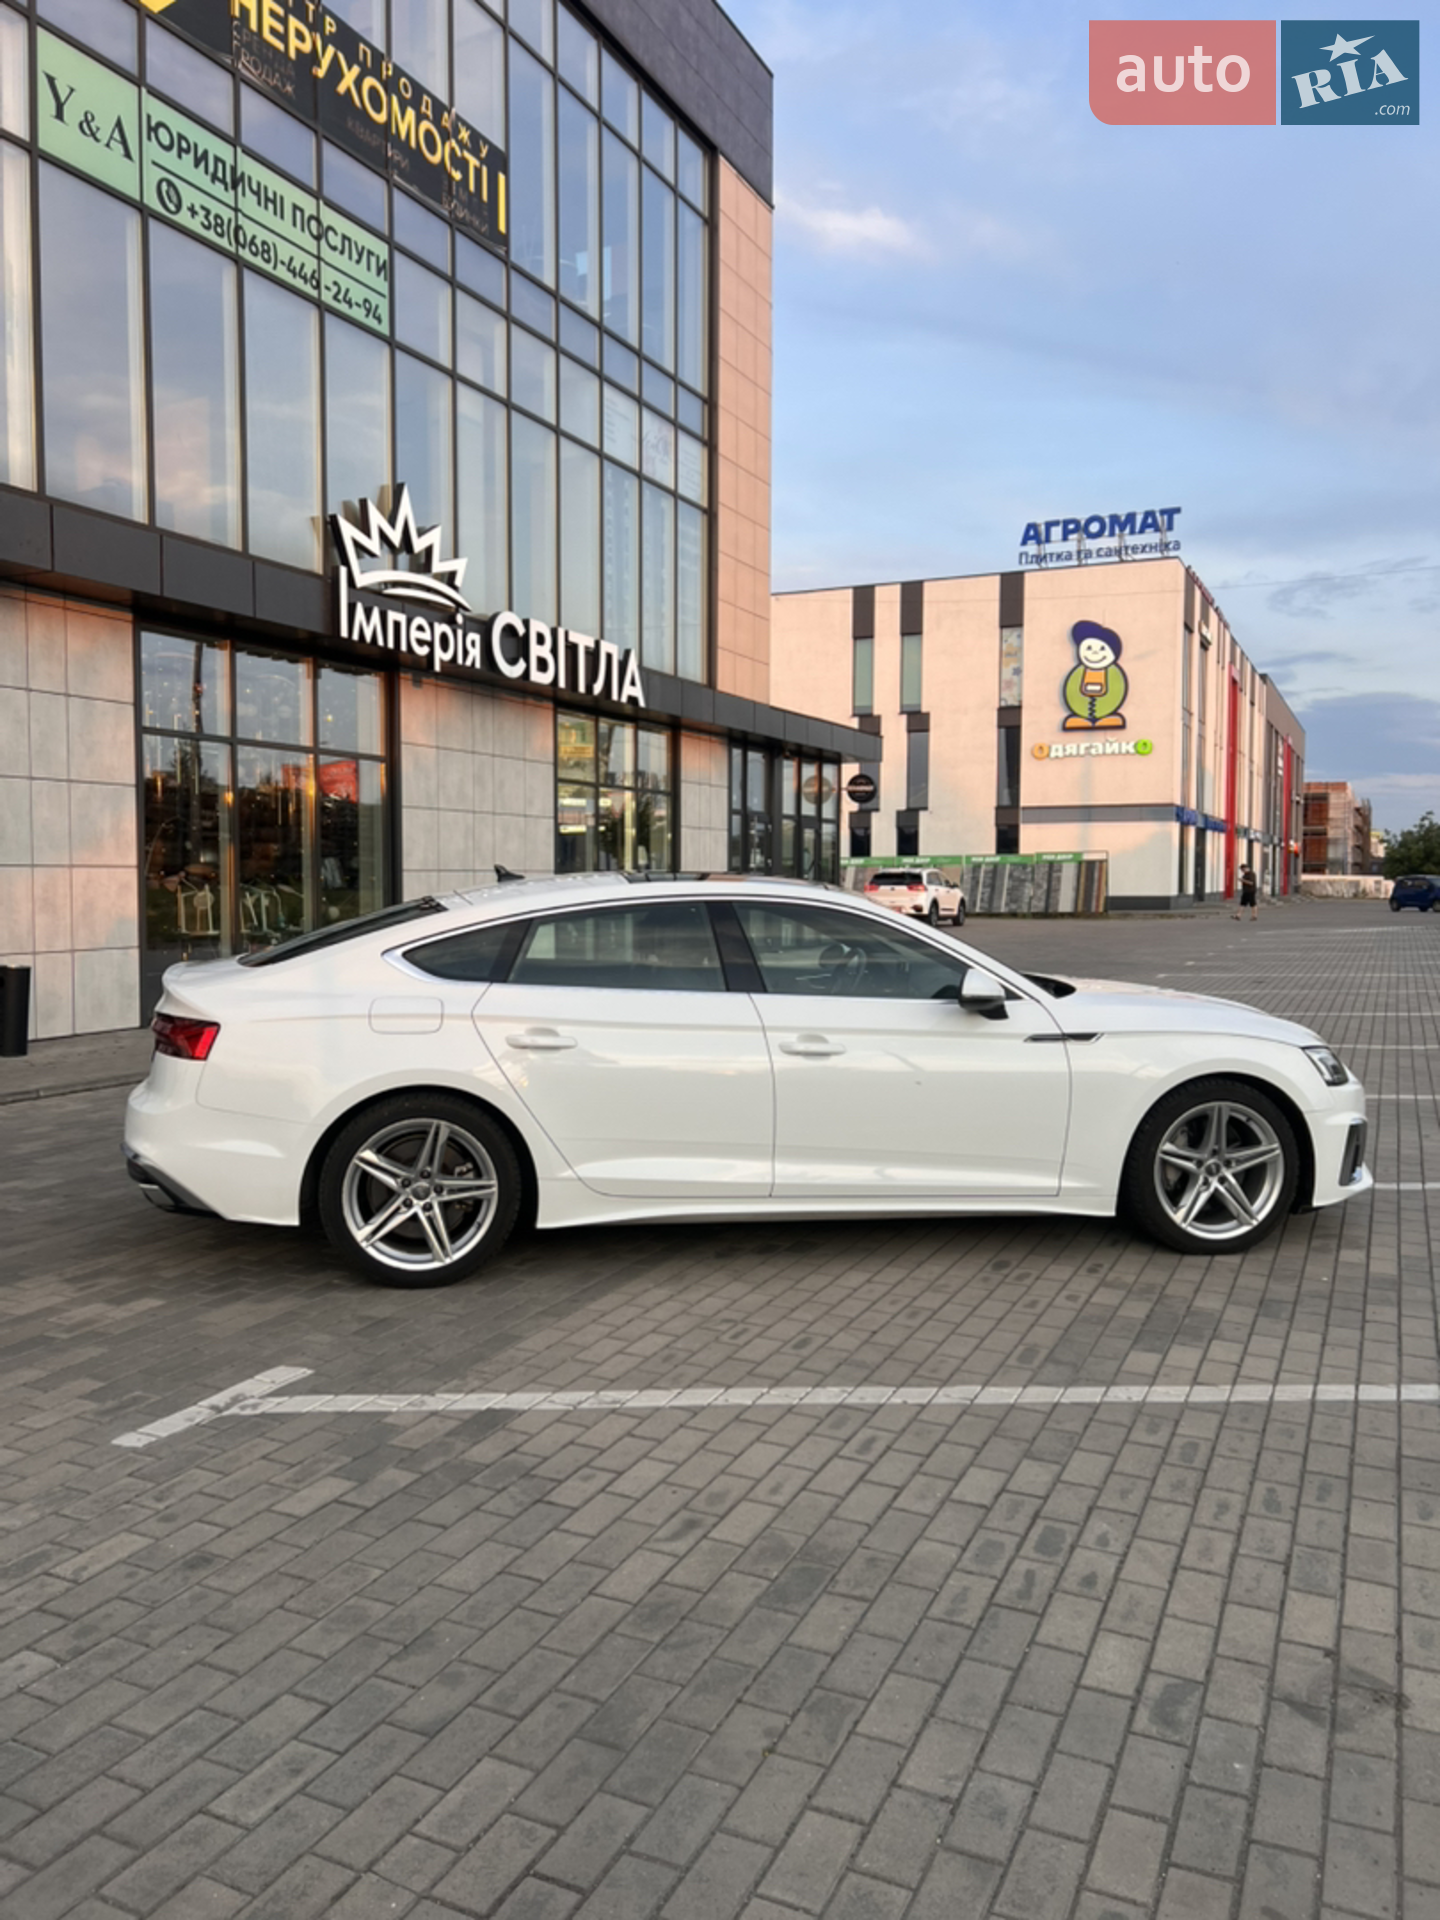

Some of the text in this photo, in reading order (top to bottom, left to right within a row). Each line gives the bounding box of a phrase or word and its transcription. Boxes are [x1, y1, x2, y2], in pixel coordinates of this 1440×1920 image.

[359, 42, 488, 159] ПРОДАЖУ
[146, 112, 388, 282] ЮРИДИЧНІ ПОСЛУГИ
[1018, 539, 1182, 567] Плитка та сантехніка
[1020, 506, 1182, 547] АГРОМАТ
[338, 565, 646, 708] Імперія СВІТЛА
